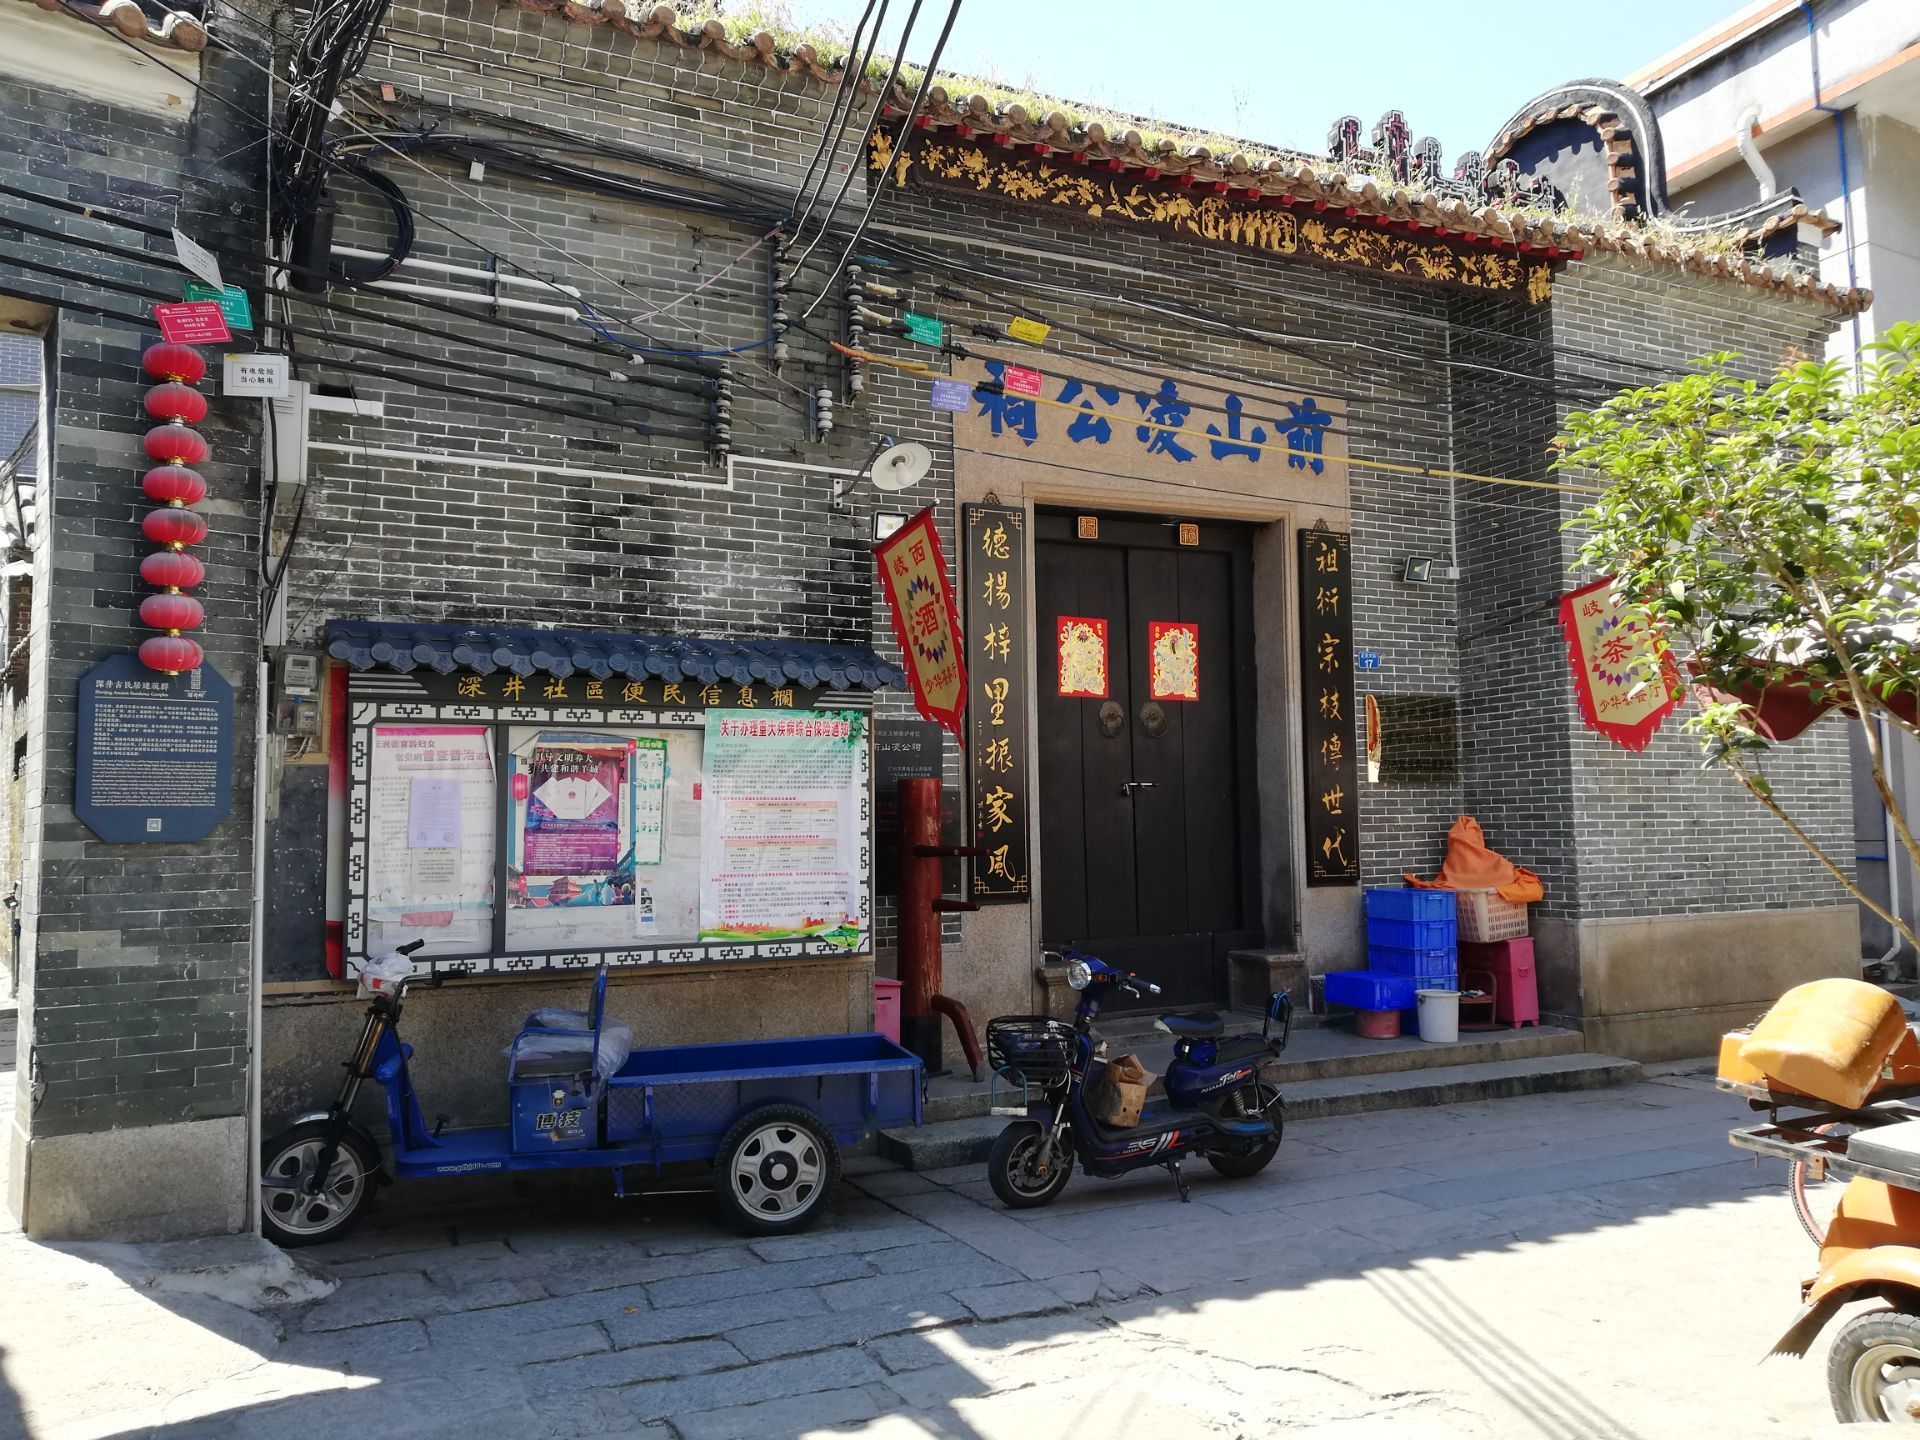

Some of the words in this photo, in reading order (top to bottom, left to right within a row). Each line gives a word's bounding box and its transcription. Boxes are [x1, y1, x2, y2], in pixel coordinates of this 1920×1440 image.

[240, 367, 274, 376] 有电危险
[240, 376, 274, 385] 当心触电
[914, 600, 940, 637] 酒
[1601, 635, 1633, 665] 茶
[1364, 659, 1374, 668] 17
[457, 674, 794, 708] 深井社區便民信息欄
[720, 718, 850, 738] 关于办理重大疾病综合保险通知
[535, 1110, 582, 1131] 博技
